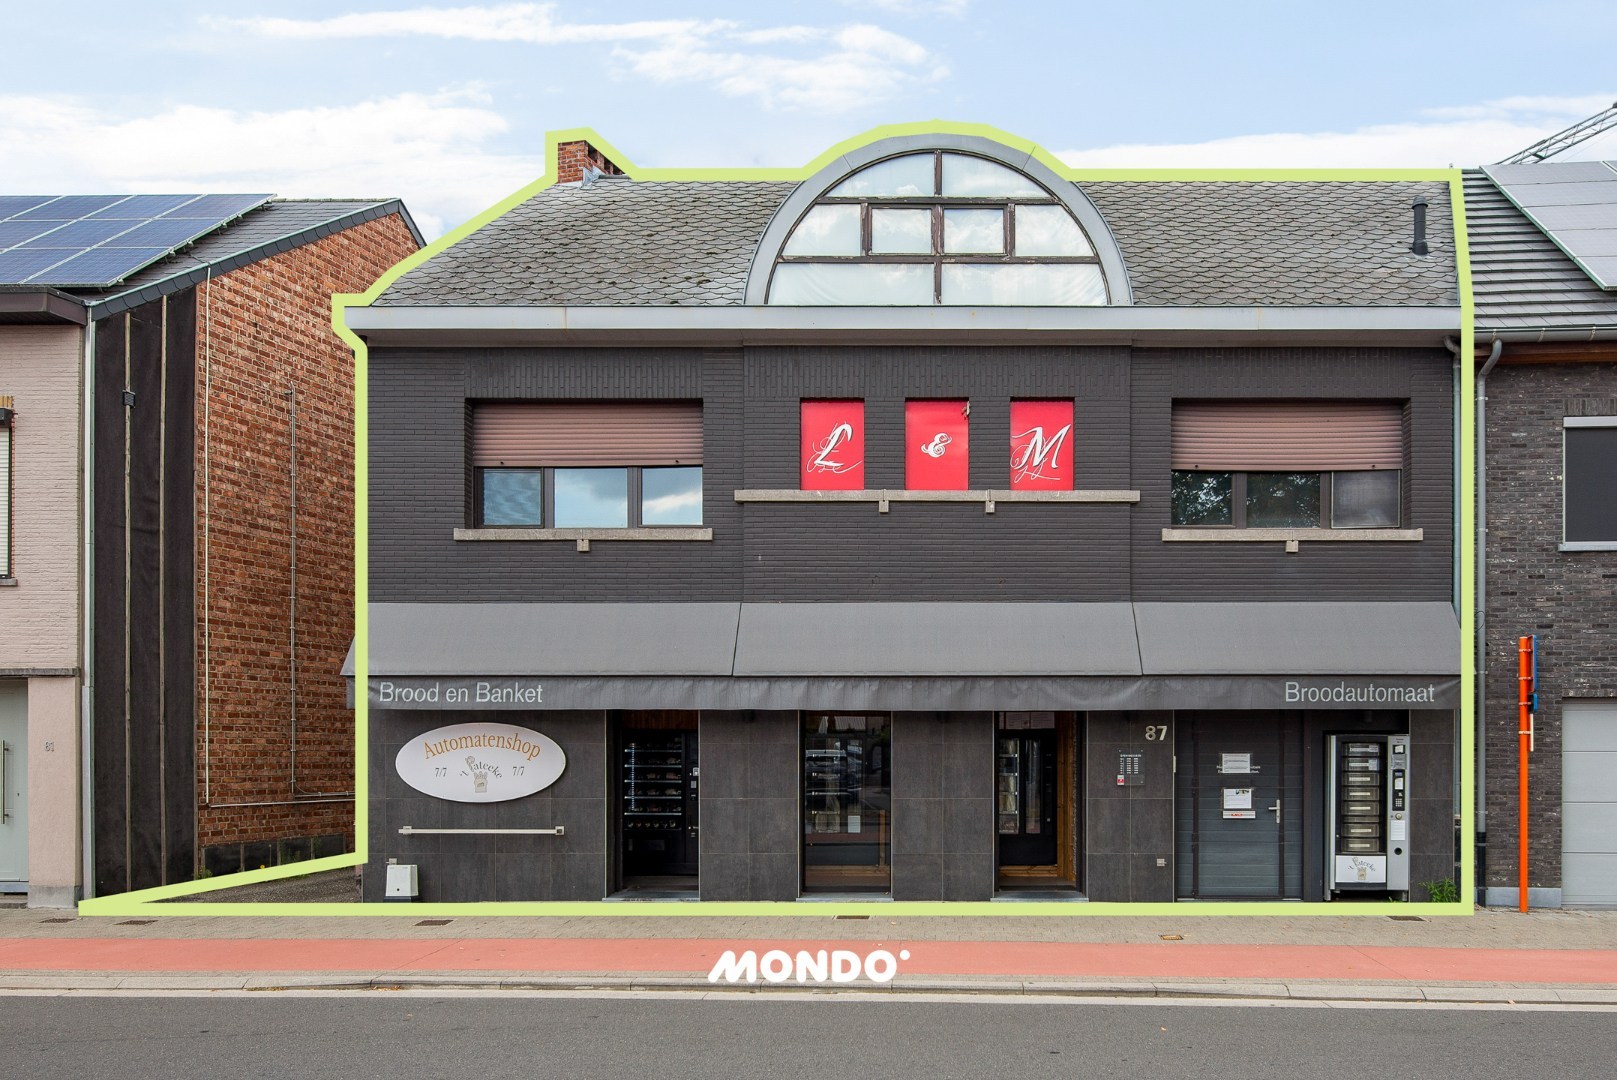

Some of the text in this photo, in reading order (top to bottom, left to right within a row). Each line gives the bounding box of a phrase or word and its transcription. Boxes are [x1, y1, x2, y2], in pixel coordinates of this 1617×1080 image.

[806, 421, 1071, 483] L & M
[379, 682, 543, 703] Brood en Banket
[1285, 681, 1435, 702] Broodautomaat
[1145, 725, 1168, 741] 87
[423, 733, 541, 761] Automatenshop
[435, 767, 447, 778] 7/7
[512, 766, 525, 777] 7/7
